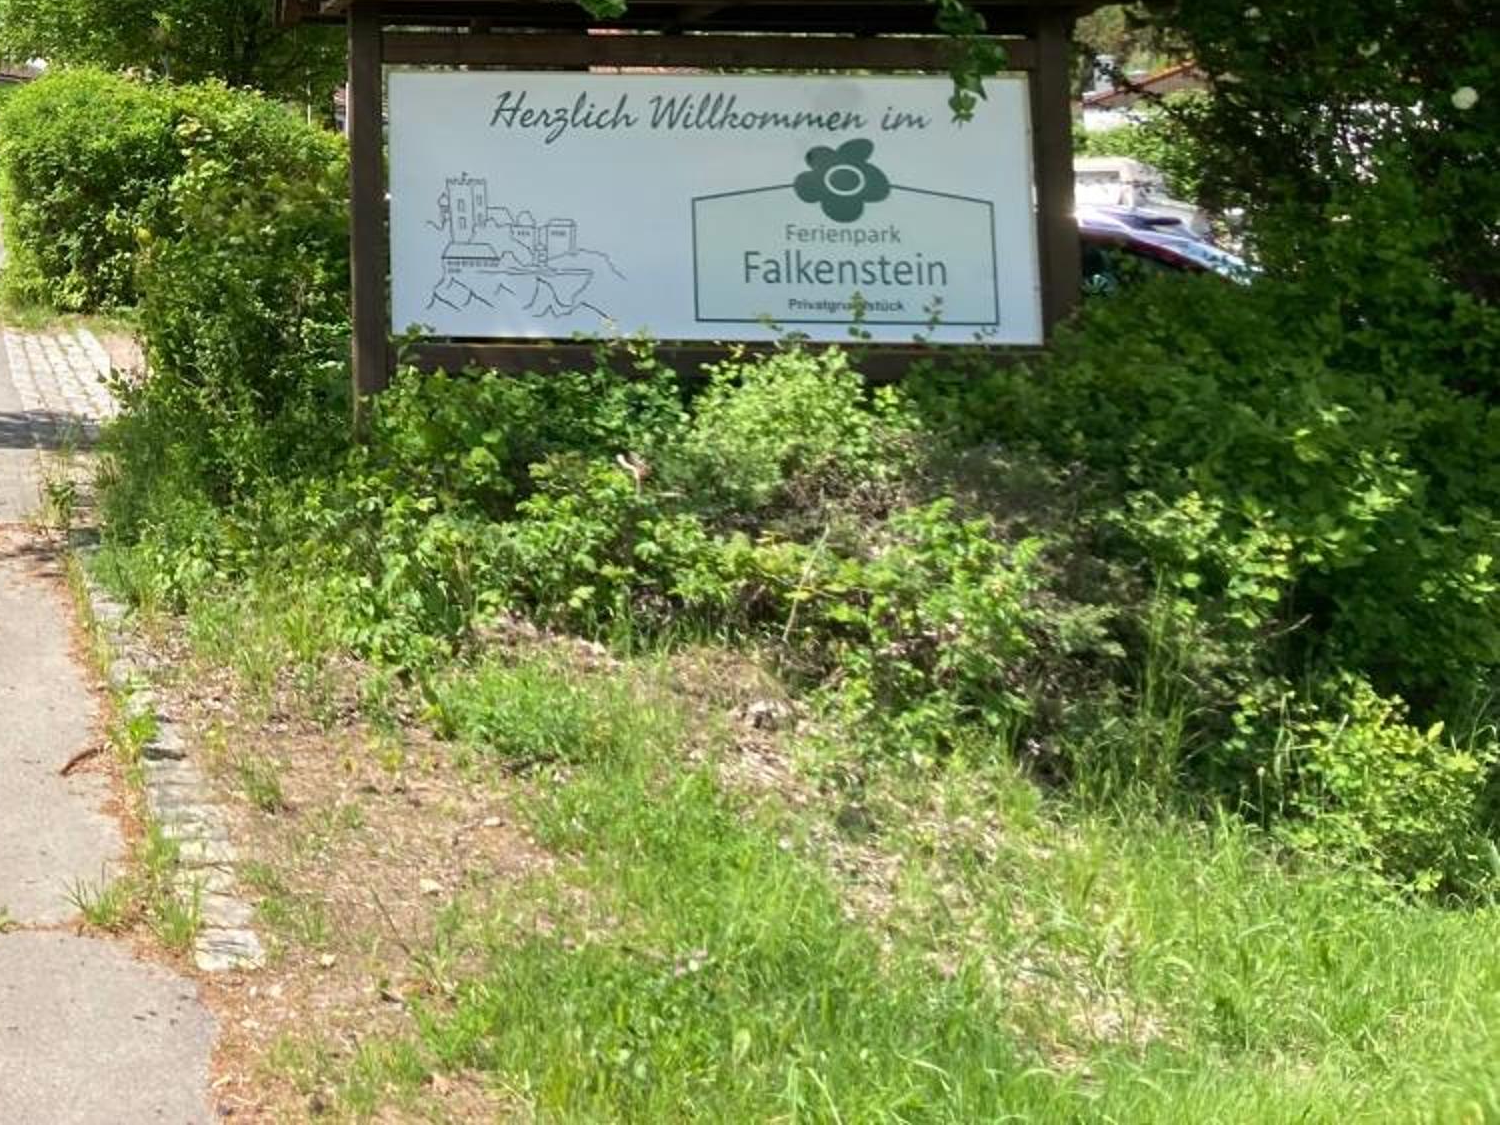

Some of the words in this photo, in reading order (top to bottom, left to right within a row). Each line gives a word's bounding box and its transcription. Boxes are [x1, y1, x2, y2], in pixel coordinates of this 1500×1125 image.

[489, 90, 639, 145] Herzlich
[649, 92, 867, 131] Willkommen
[881, 106, 932, 131] im
[786, 225, 901, 246] Ferienpark
[744, 249, 947, 286] Falkenstein
[788, 298, 902, 313] Privatgrustück
